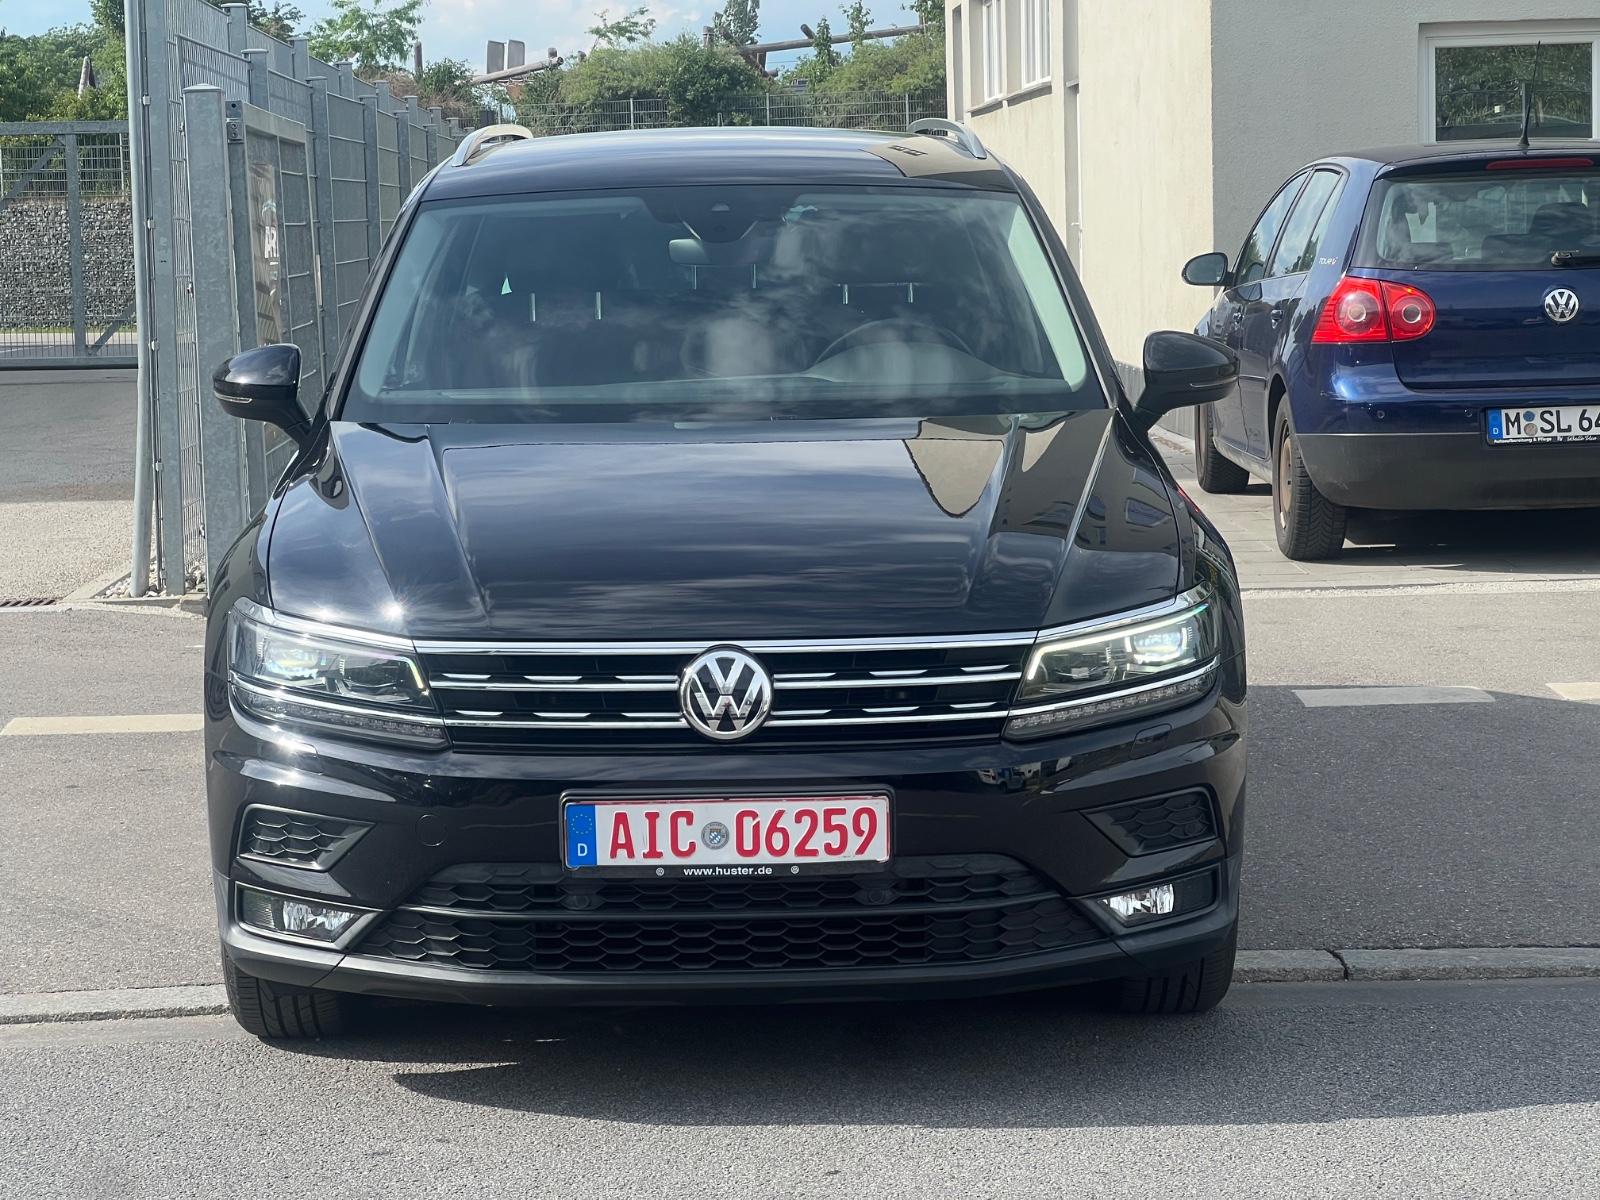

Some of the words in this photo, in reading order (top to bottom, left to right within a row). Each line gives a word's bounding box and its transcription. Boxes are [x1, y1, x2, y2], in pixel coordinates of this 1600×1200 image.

[1544, 288, 1579, 322] VW
[1493, 427, 1499, 435] D
[1504, 411, 1522, 436] M
[1539, 409, 1572, 434] SL
[680, 650, 772, 740] VW
[577, 843, 588, 857] D
[609, 809, 697, 859] AIC
[734, 806, 878, 858] 06259
[683, 865, 773, 876] www.huster.de
